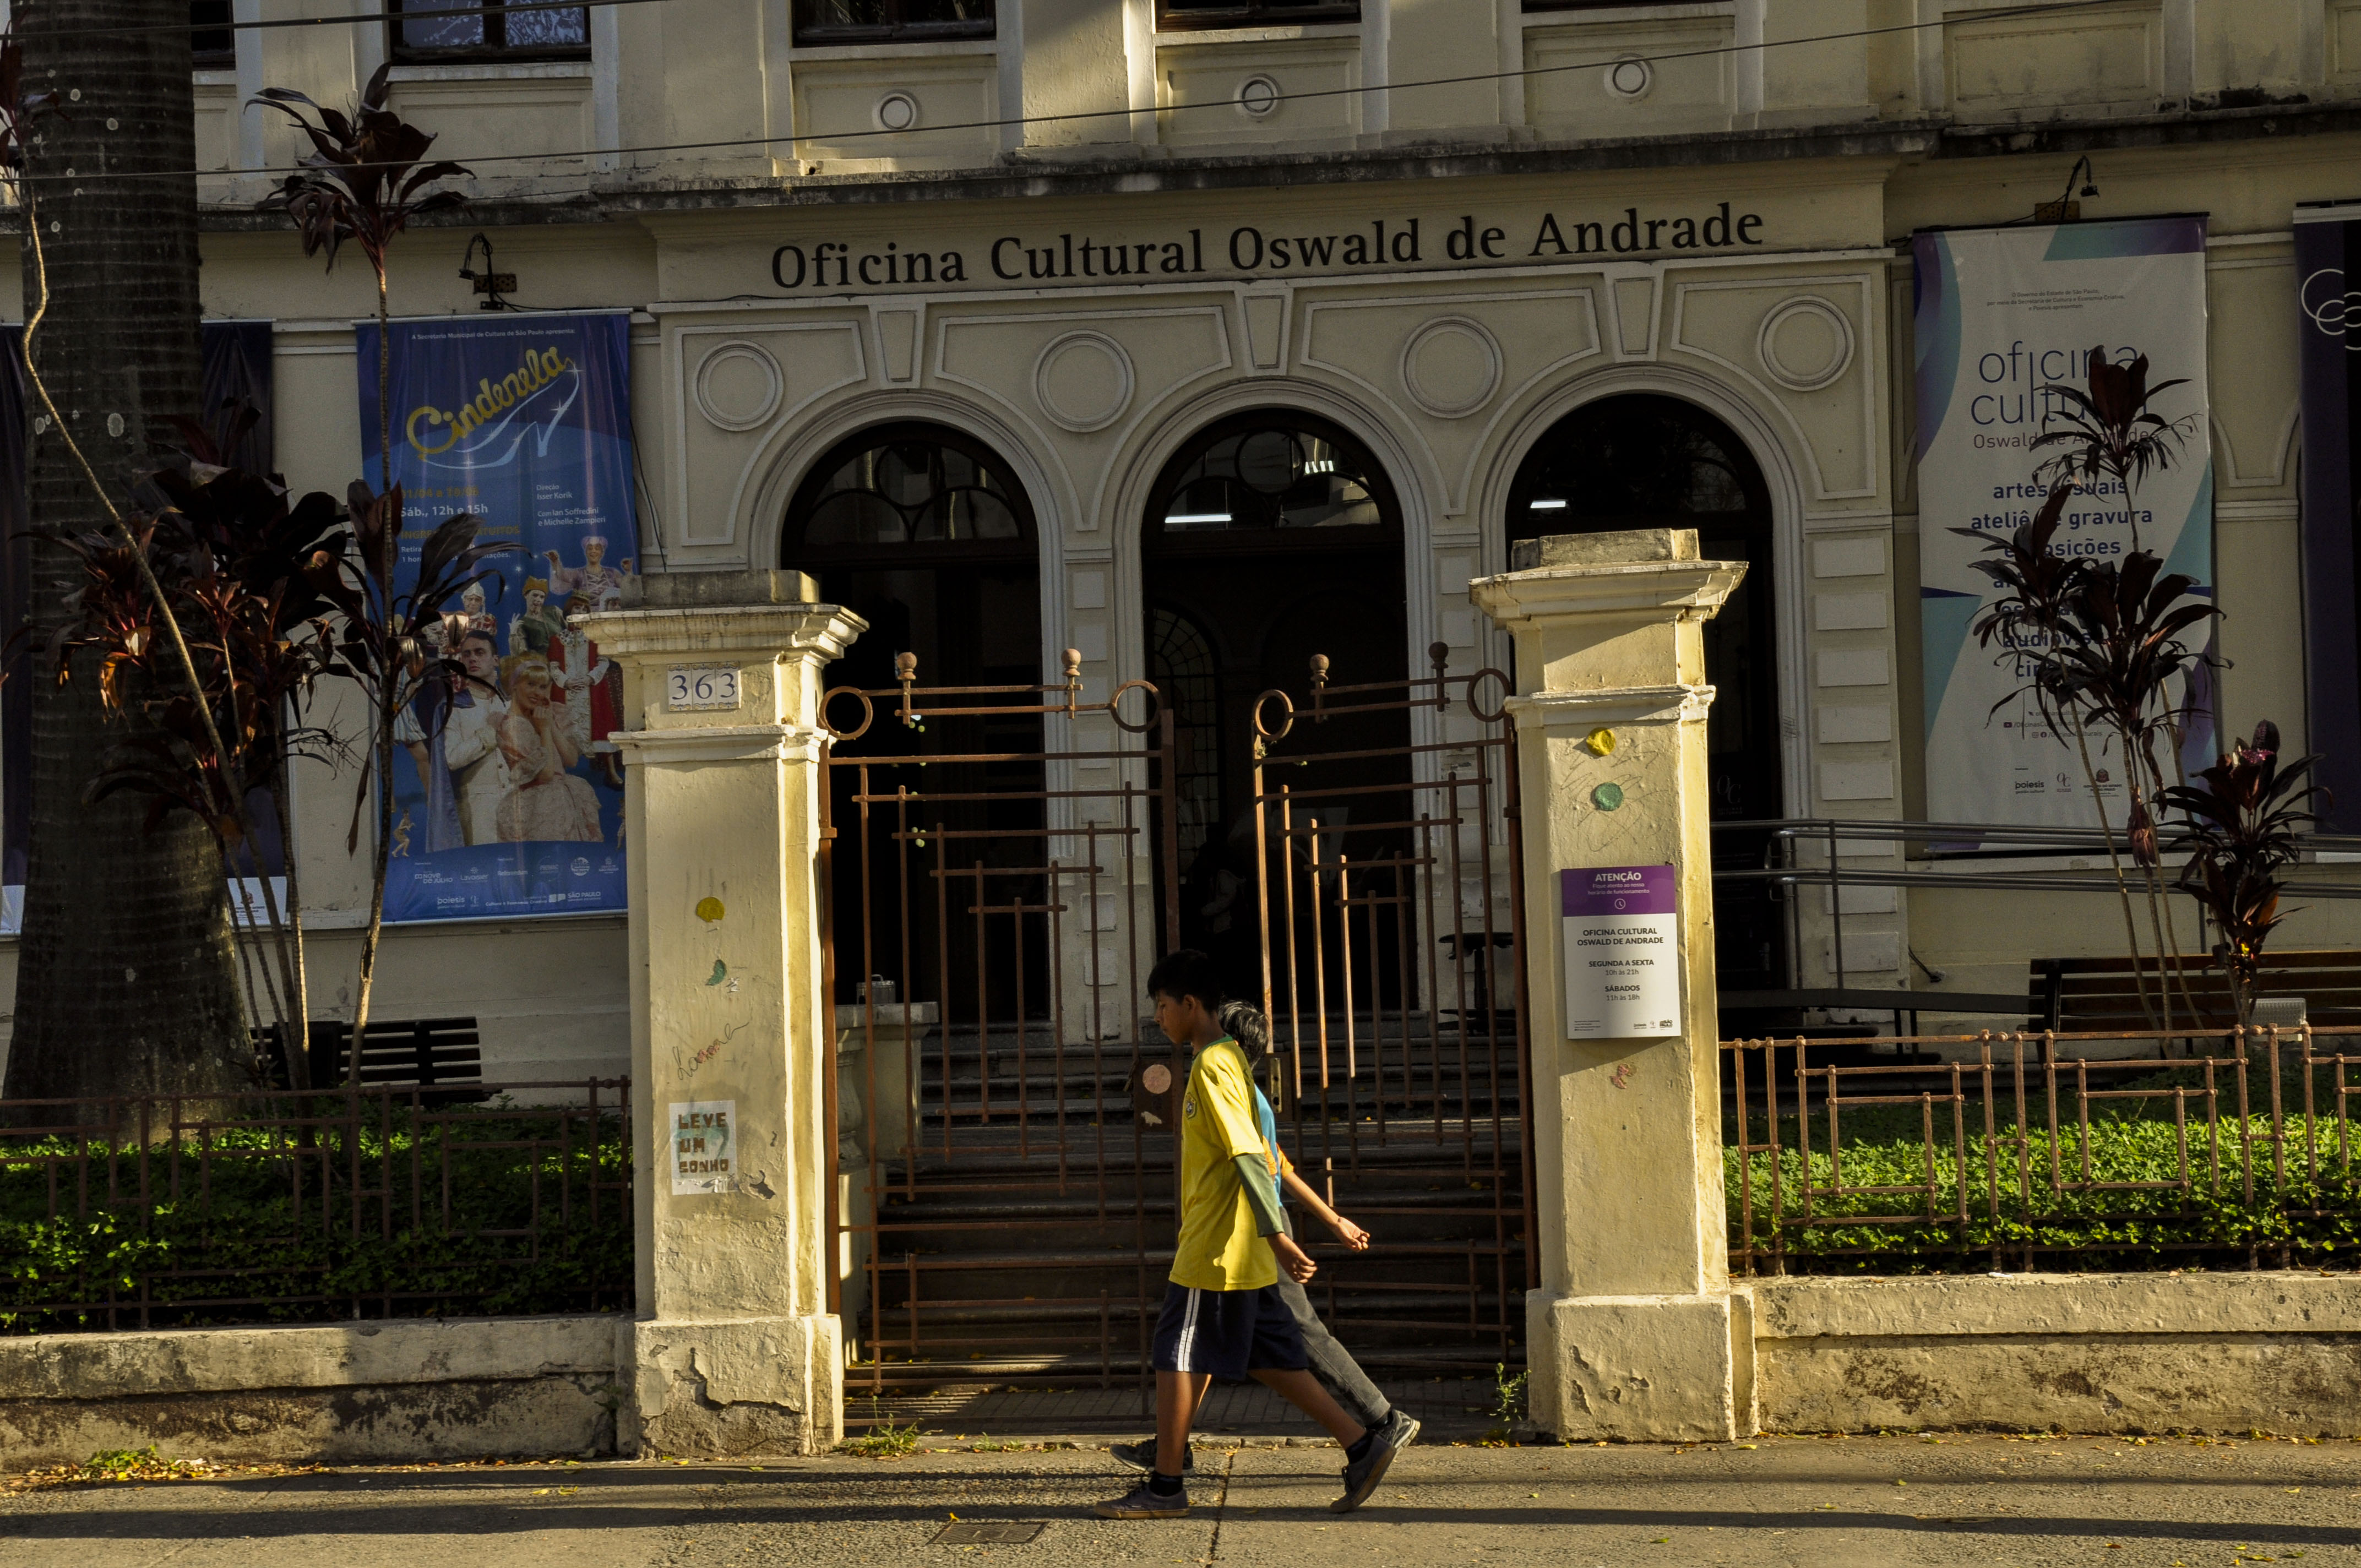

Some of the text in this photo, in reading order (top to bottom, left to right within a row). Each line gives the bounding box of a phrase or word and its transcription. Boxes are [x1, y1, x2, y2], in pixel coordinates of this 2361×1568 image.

[772, 202, 1763, 289] Oficina Cultural Oswald de Andrade
[1993, 482, 2048, 499] artes
[401, 507, 428, 518] Sáb.,
[432, 505, 454, 515] 12h
[467, 504, 488, 514] 15h
[564, 507, 599, 516] Soffredini
[543, 517, 574, 526] Michelle
[574, 516, 606, 525] Zampieri
[1971, 510, 2030, 529] ateliê
[2069, 510, 2153, 530] gravura
[672, 672, 736, 700] 363
[2015, 780, 2044, 790] poiesis
[1595, 871, 1642, 883] ATENÇÃO
[437, 896, 465, 906] poiesis
[1582, 927, 1657, 937] OFICINA CULTURAL
[1577, 938, 1612, 946] OSWALD
[1625, 937, 1664, 945] ANDRADE
[1604, 984, 1640, 992] SÁBADOS
[678, 1112, 727, 1130] LEVE
[679, 1136, 705, 1153] UM
[679, 1158, 729, 1173] SONHO
